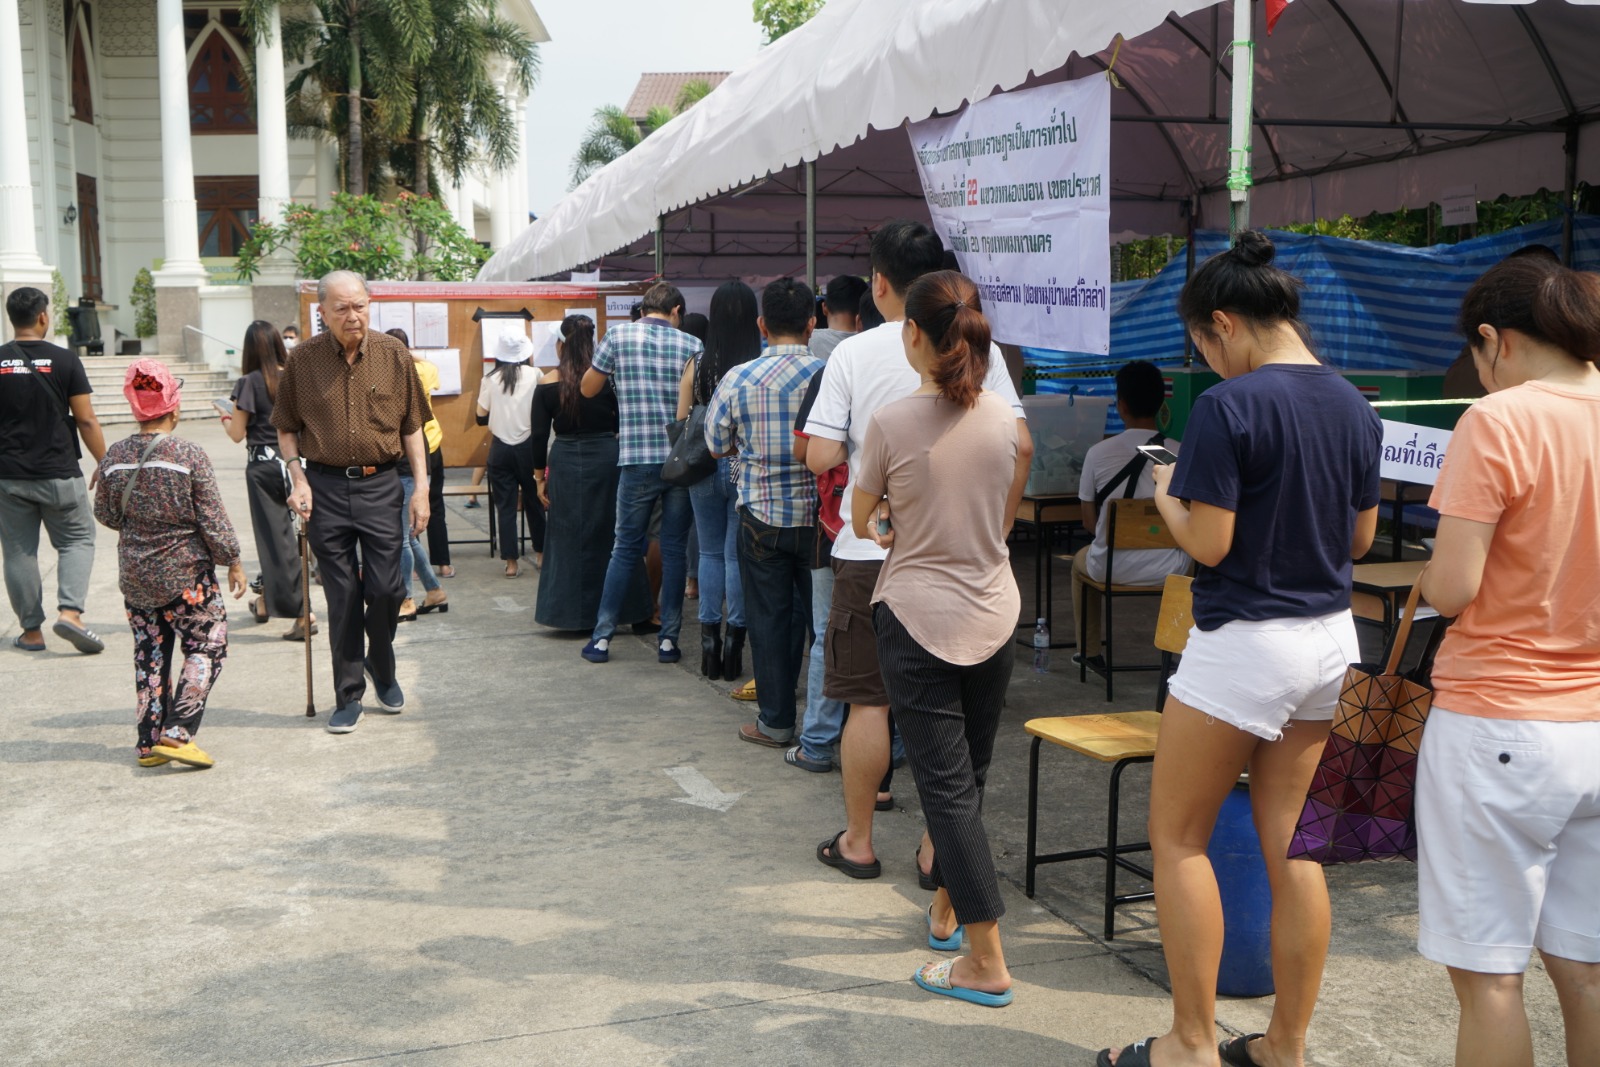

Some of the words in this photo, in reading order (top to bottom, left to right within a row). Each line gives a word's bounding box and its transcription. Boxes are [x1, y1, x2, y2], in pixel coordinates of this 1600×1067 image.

[967, 178, 978, 206] 22
[980, 182, 1044, 205] แขวงหนองบอน
[1047, 172, 1101, 200] เขตประเวศ
[981, 234, 1052, 262] กรุงเทพมหานคร
[1, 359, 52, 367] CUSTMER
[1380, 432, 1446, 470] ณที่เลือ
